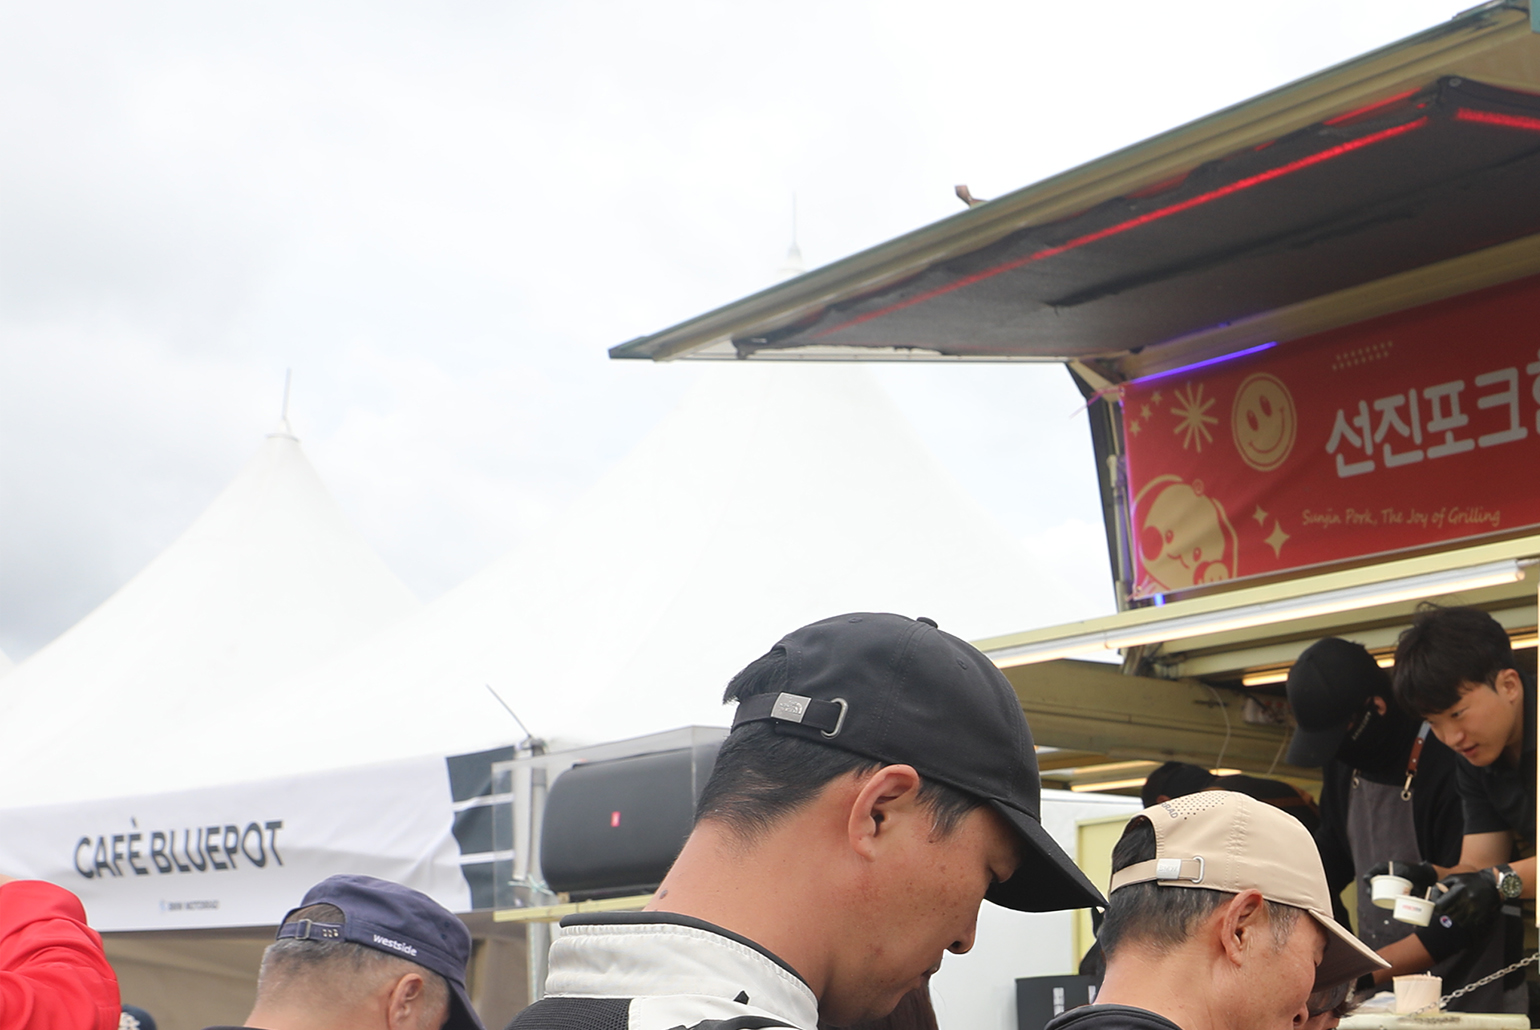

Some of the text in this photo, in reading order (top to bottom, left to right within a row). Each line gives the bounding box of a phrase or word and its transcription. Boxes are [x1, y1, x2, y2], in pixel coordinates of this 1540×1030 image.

[1381, 507, 1403, 524] The
[1406, 508, 1429, 529] Joy
[1432, 507, 1446, 529] of
[1448, 506, 1500, 527] Grilling
[150, 821, 283, 875] BLUEPOT
[373, 933, 417, 957] westside
